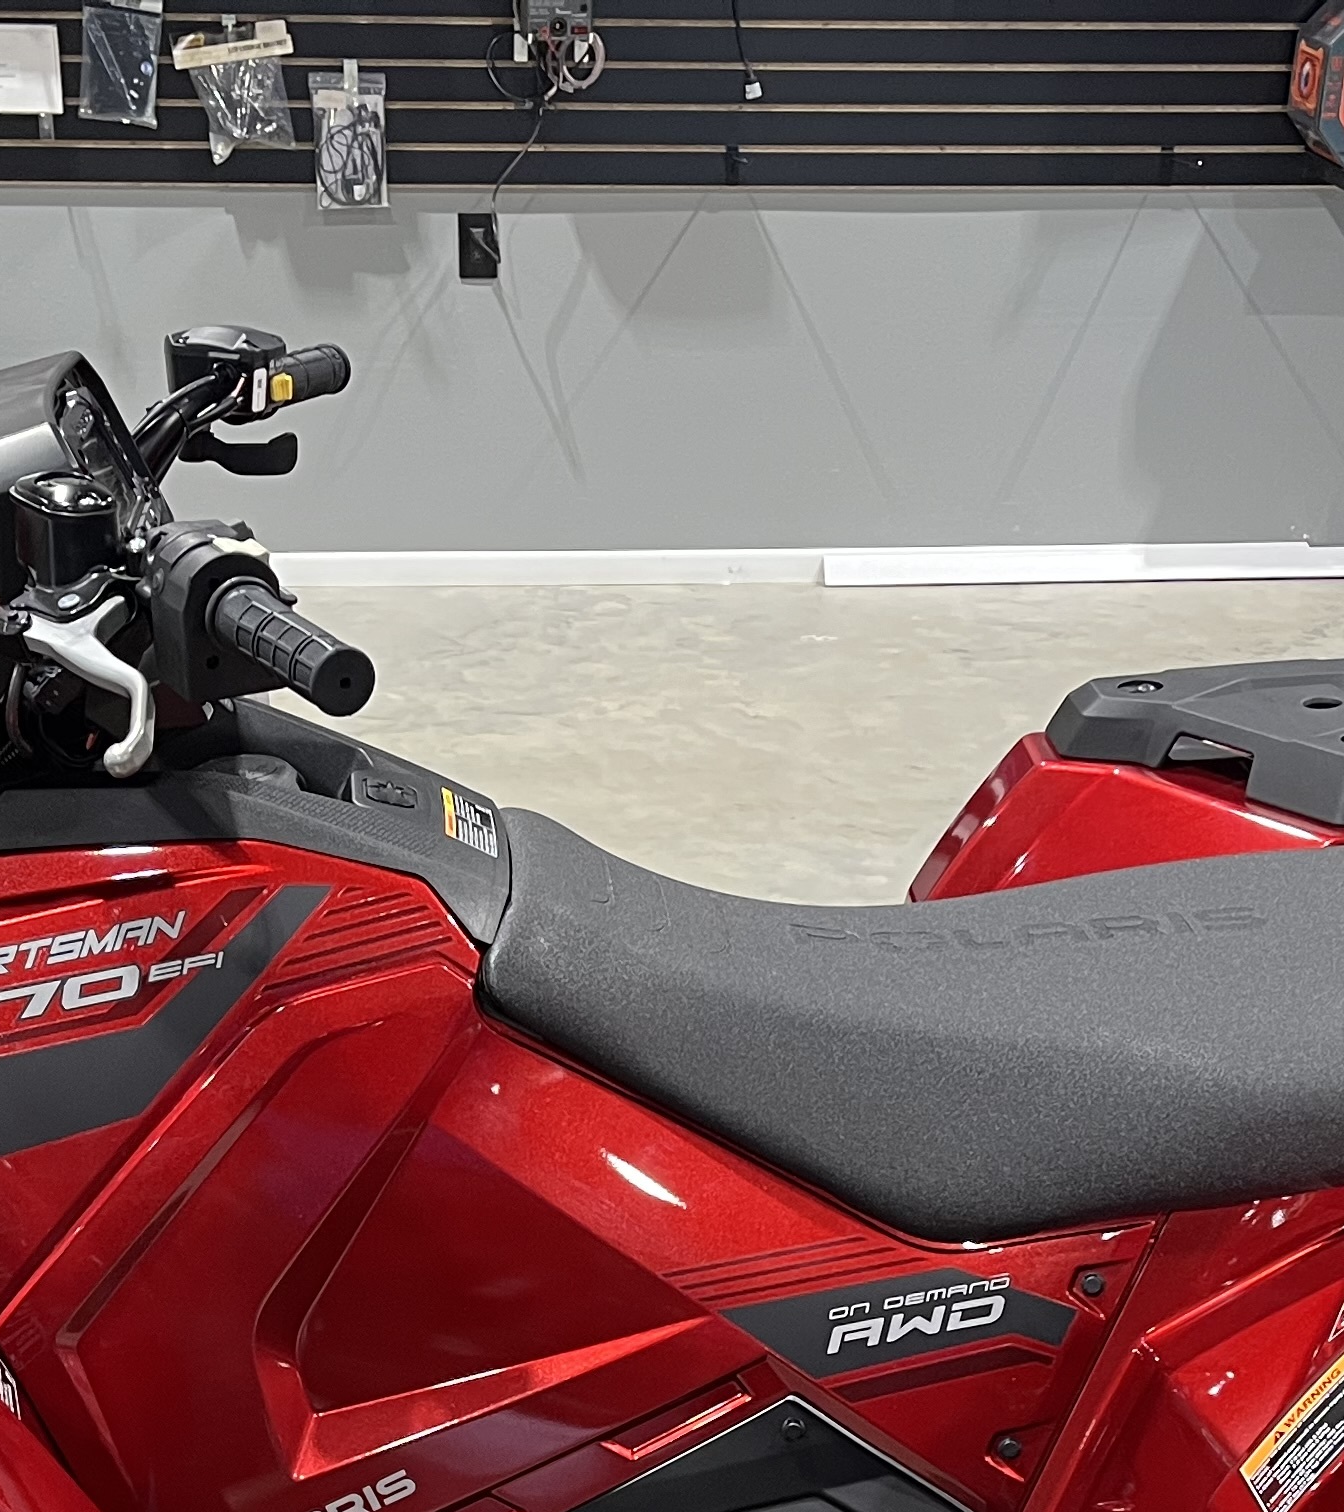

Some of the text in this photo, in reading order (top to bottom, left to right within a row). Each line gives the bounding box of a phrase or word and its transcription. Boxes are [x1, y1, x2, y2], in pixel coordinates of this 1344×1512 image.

[147, 951, 224, 984] EFI
[826, 1294, 1006, 1355] AWD
[828, 1275, 1011, 1321] ON DEMAND
[1283, 1367, 1342, 1429] WARNING
